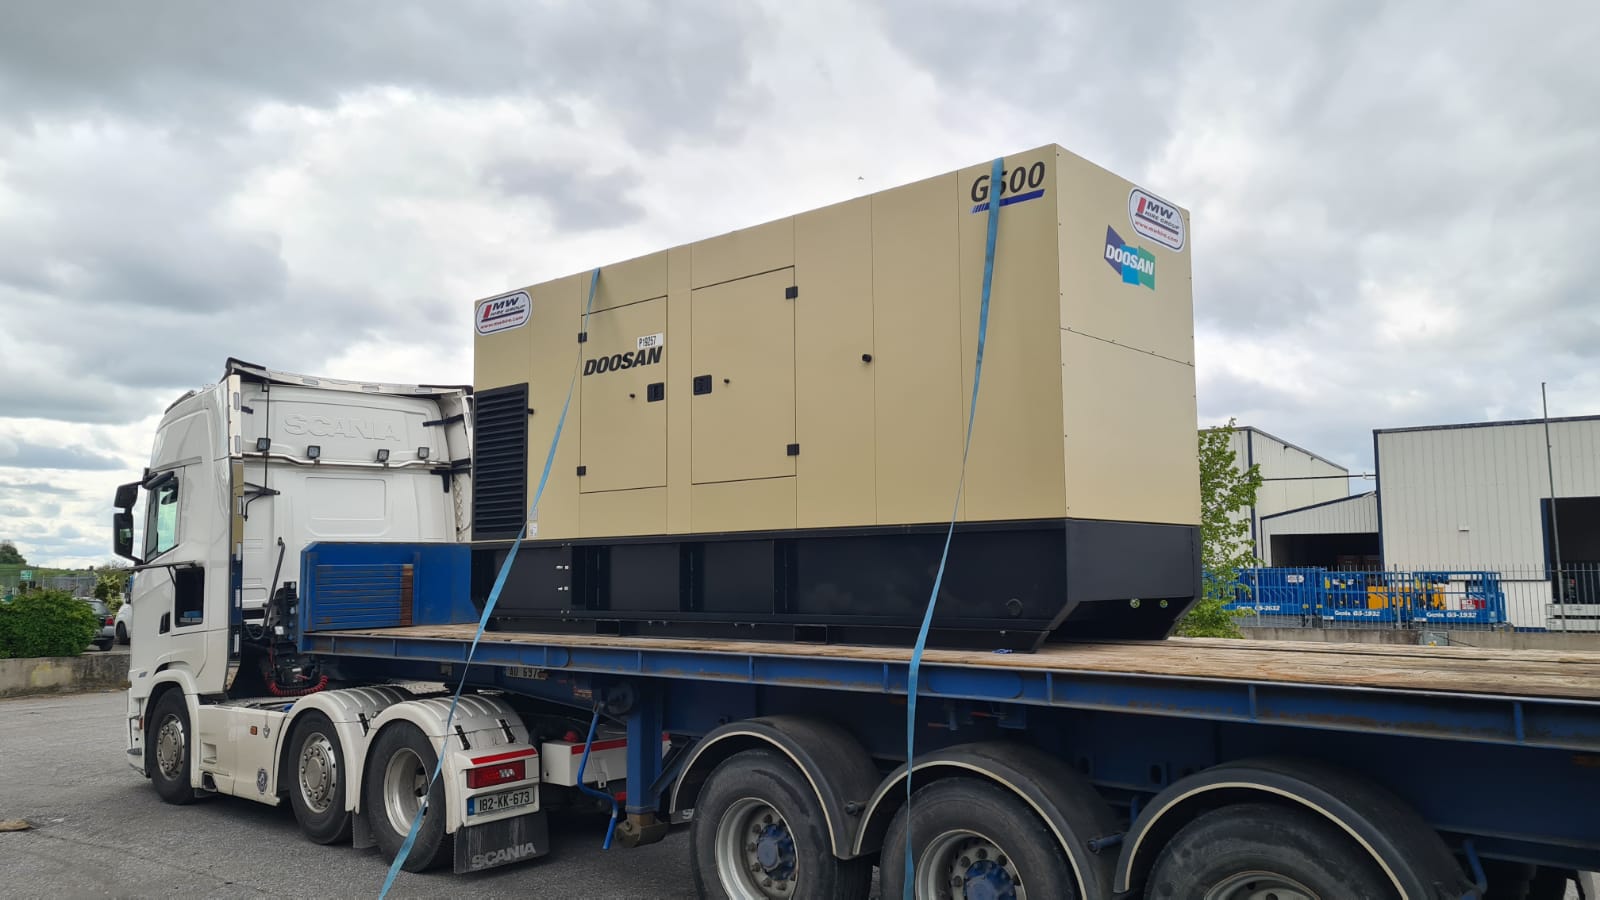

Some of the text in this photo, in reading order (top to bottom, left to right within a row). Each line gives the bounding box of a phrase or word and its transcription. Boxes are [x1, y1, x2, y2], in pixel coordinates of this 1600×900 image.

[1144, 211, 1180, 230] HIRE GROUP
[1146, 200, 1174, 219] MW
[1105, 244, 1154, 276] DOOSAN
[492, 297, 519, 311] MW
[583, 346, 663, 377] DOOSAN
[284, 416, 401, 441] SCANIA
[479, 791, 530, 812] 182-KK-673
[471, 842, 537, 869] SCANIA
